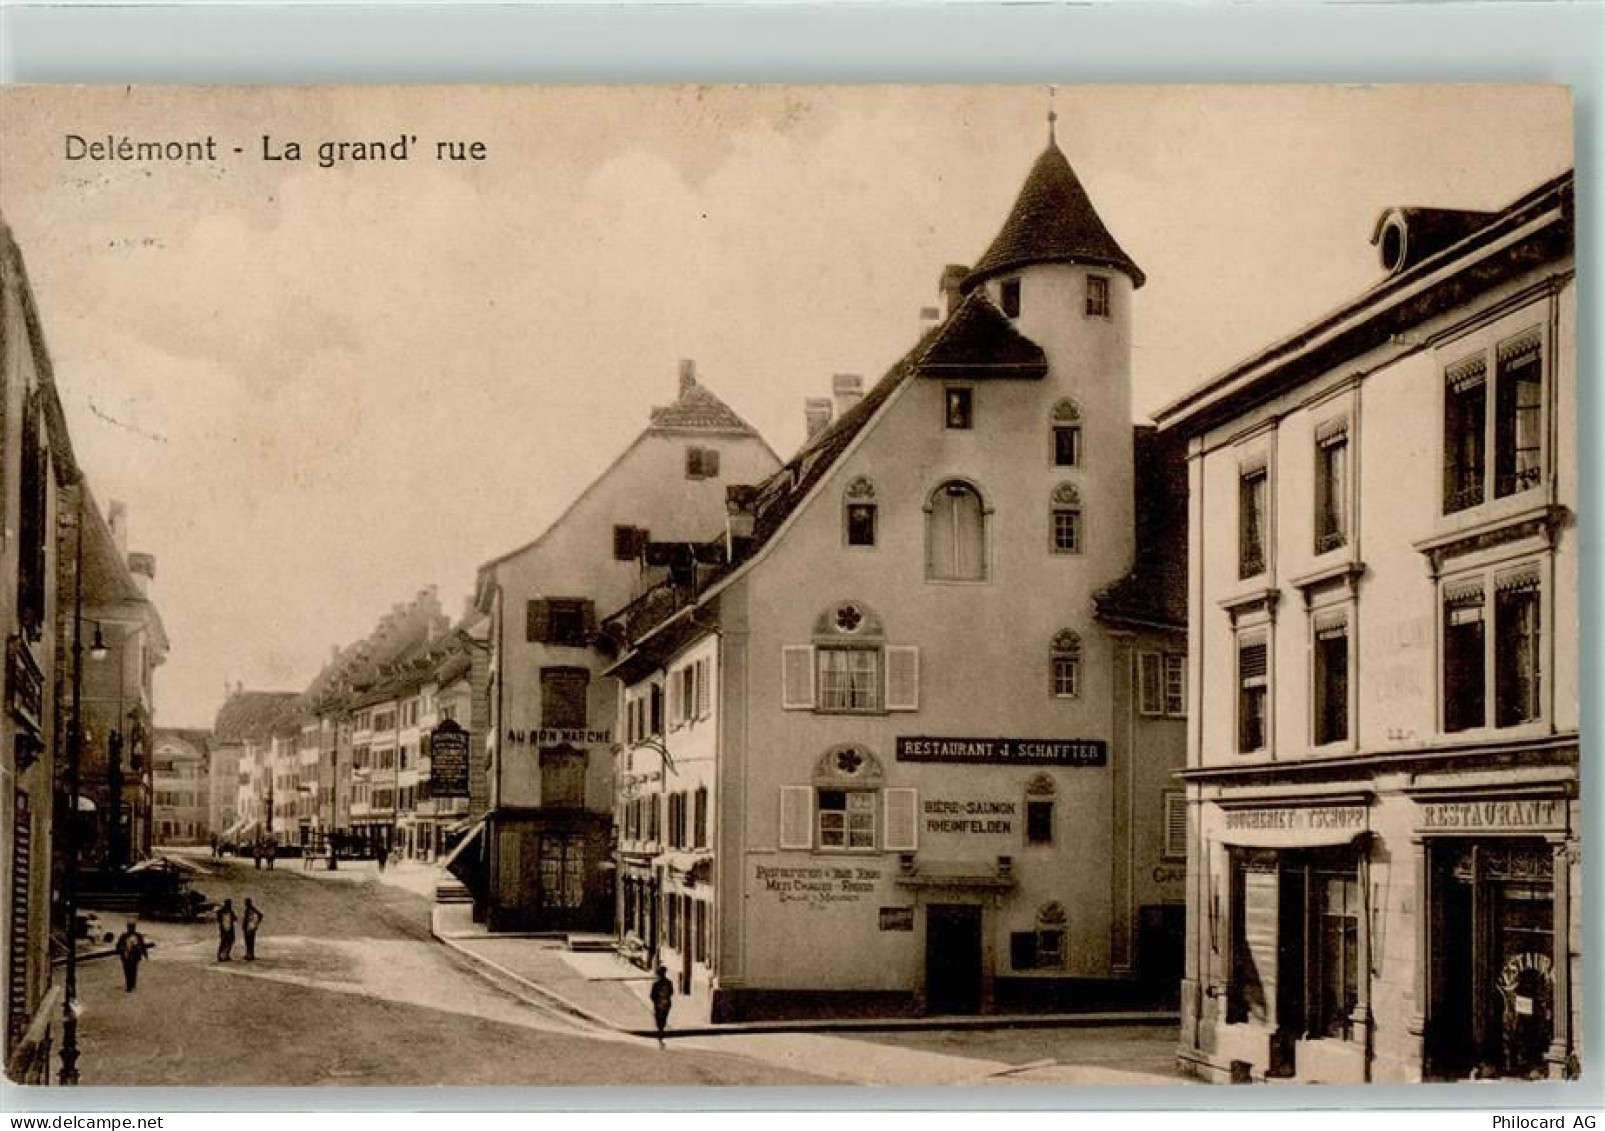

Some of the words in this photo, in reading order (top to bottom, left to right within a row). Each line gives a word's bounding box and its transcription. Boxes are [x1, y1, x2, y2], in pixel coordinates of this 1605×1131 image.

[65, 135, 217, 161] Delémont
[263, 135, 301, 161] La
[318, 135, 418, 168] grand'
[436, 141, 488, 161] rue
[507, 730, 526, 743] AU
[904, 741, 992, 757] RESTAURANT
[1018, 744, 1099, 759] SCHAFFTER
[1425, 800, 1556, 827] RESTAURANT
[927, 820, 1011, 834] RHEINFELDEN
